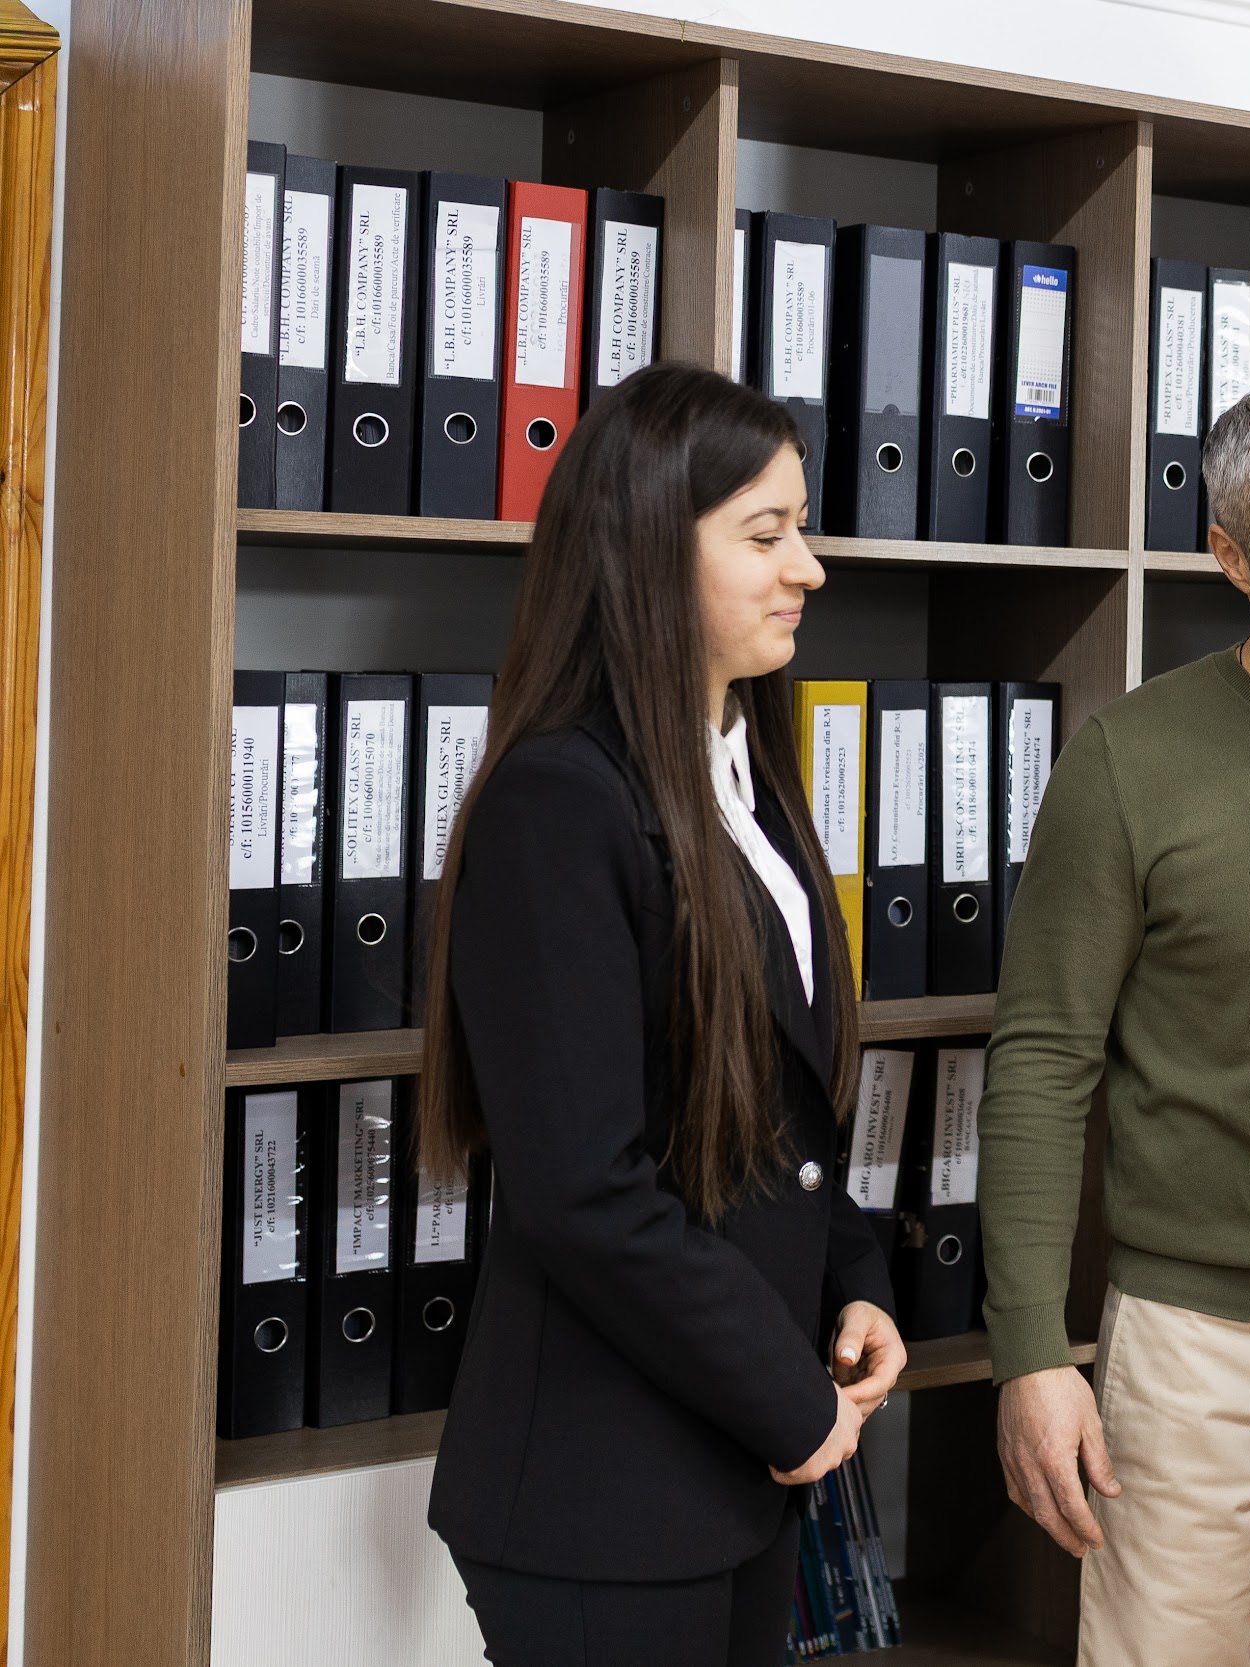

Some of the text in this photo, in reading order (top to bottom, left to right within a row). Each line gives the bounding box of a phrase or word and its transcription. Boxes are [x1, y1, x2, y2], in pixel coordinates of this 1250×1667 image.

[255, 194, 261, 203] de
[284, 196, 292, 223] SRL
[360, 211, 369, 235] SRL
[392, 193, 400, 232] verificare
[447, 209, 458, 236] SRL
[264, 241, 271, 249] de
[392, 234, 399, 243] de
[523, 226, 532, 249] SRL
[617, 229, 627, 254] SRL
[390, 245, 399, 299] parcurs/Acte
[641, 243, 651, 318] constituire/Contracte
[786, 260, 794, 280] SRL
[1041, 274, 1059, 287] hello
[296, 228, 308, 343] c/f: 1016600035589
[311, 256, 320, 319] Dări de seamă
[372, 235, 384, 334] c/f:1016600035589
[461, 236, 473, 345] c/f:1016600035589
[477, 277, 486, 306] Livrări
[389, 301, 396, 311] de
[538, 251, 550, 349] c/f: 1016600035589
[627, 251, 640, 360] c/f: 1016600035589
[641, 320, 647, 328] de
[785, 291, 793, 342] COMPANY
[1176, 315, 1184, 389] 1012600040381
[970, 363, 975, 372] de
[351, 713, 361, 739] SRL
[441, 717, 451, 743] SRL
[823, 731, 831, 745] din
[242, 738, 254, 859] c/f: 1015600011940
[258, 759, 269, 837] Livrări/Procurări
[363, 733, 375, 843] c/f: 1006600015070
[873, 1056, 886, 1081] SRL
[947, 1056, 957, 1081] SRL
[356, 1098, 364, 1120] SRL
[255, 1130, 263, 1152] SRL
[267, 1140, 276, 1233] c/f: 1021600043722
[366, 1205, 374, 1221] c/f:
